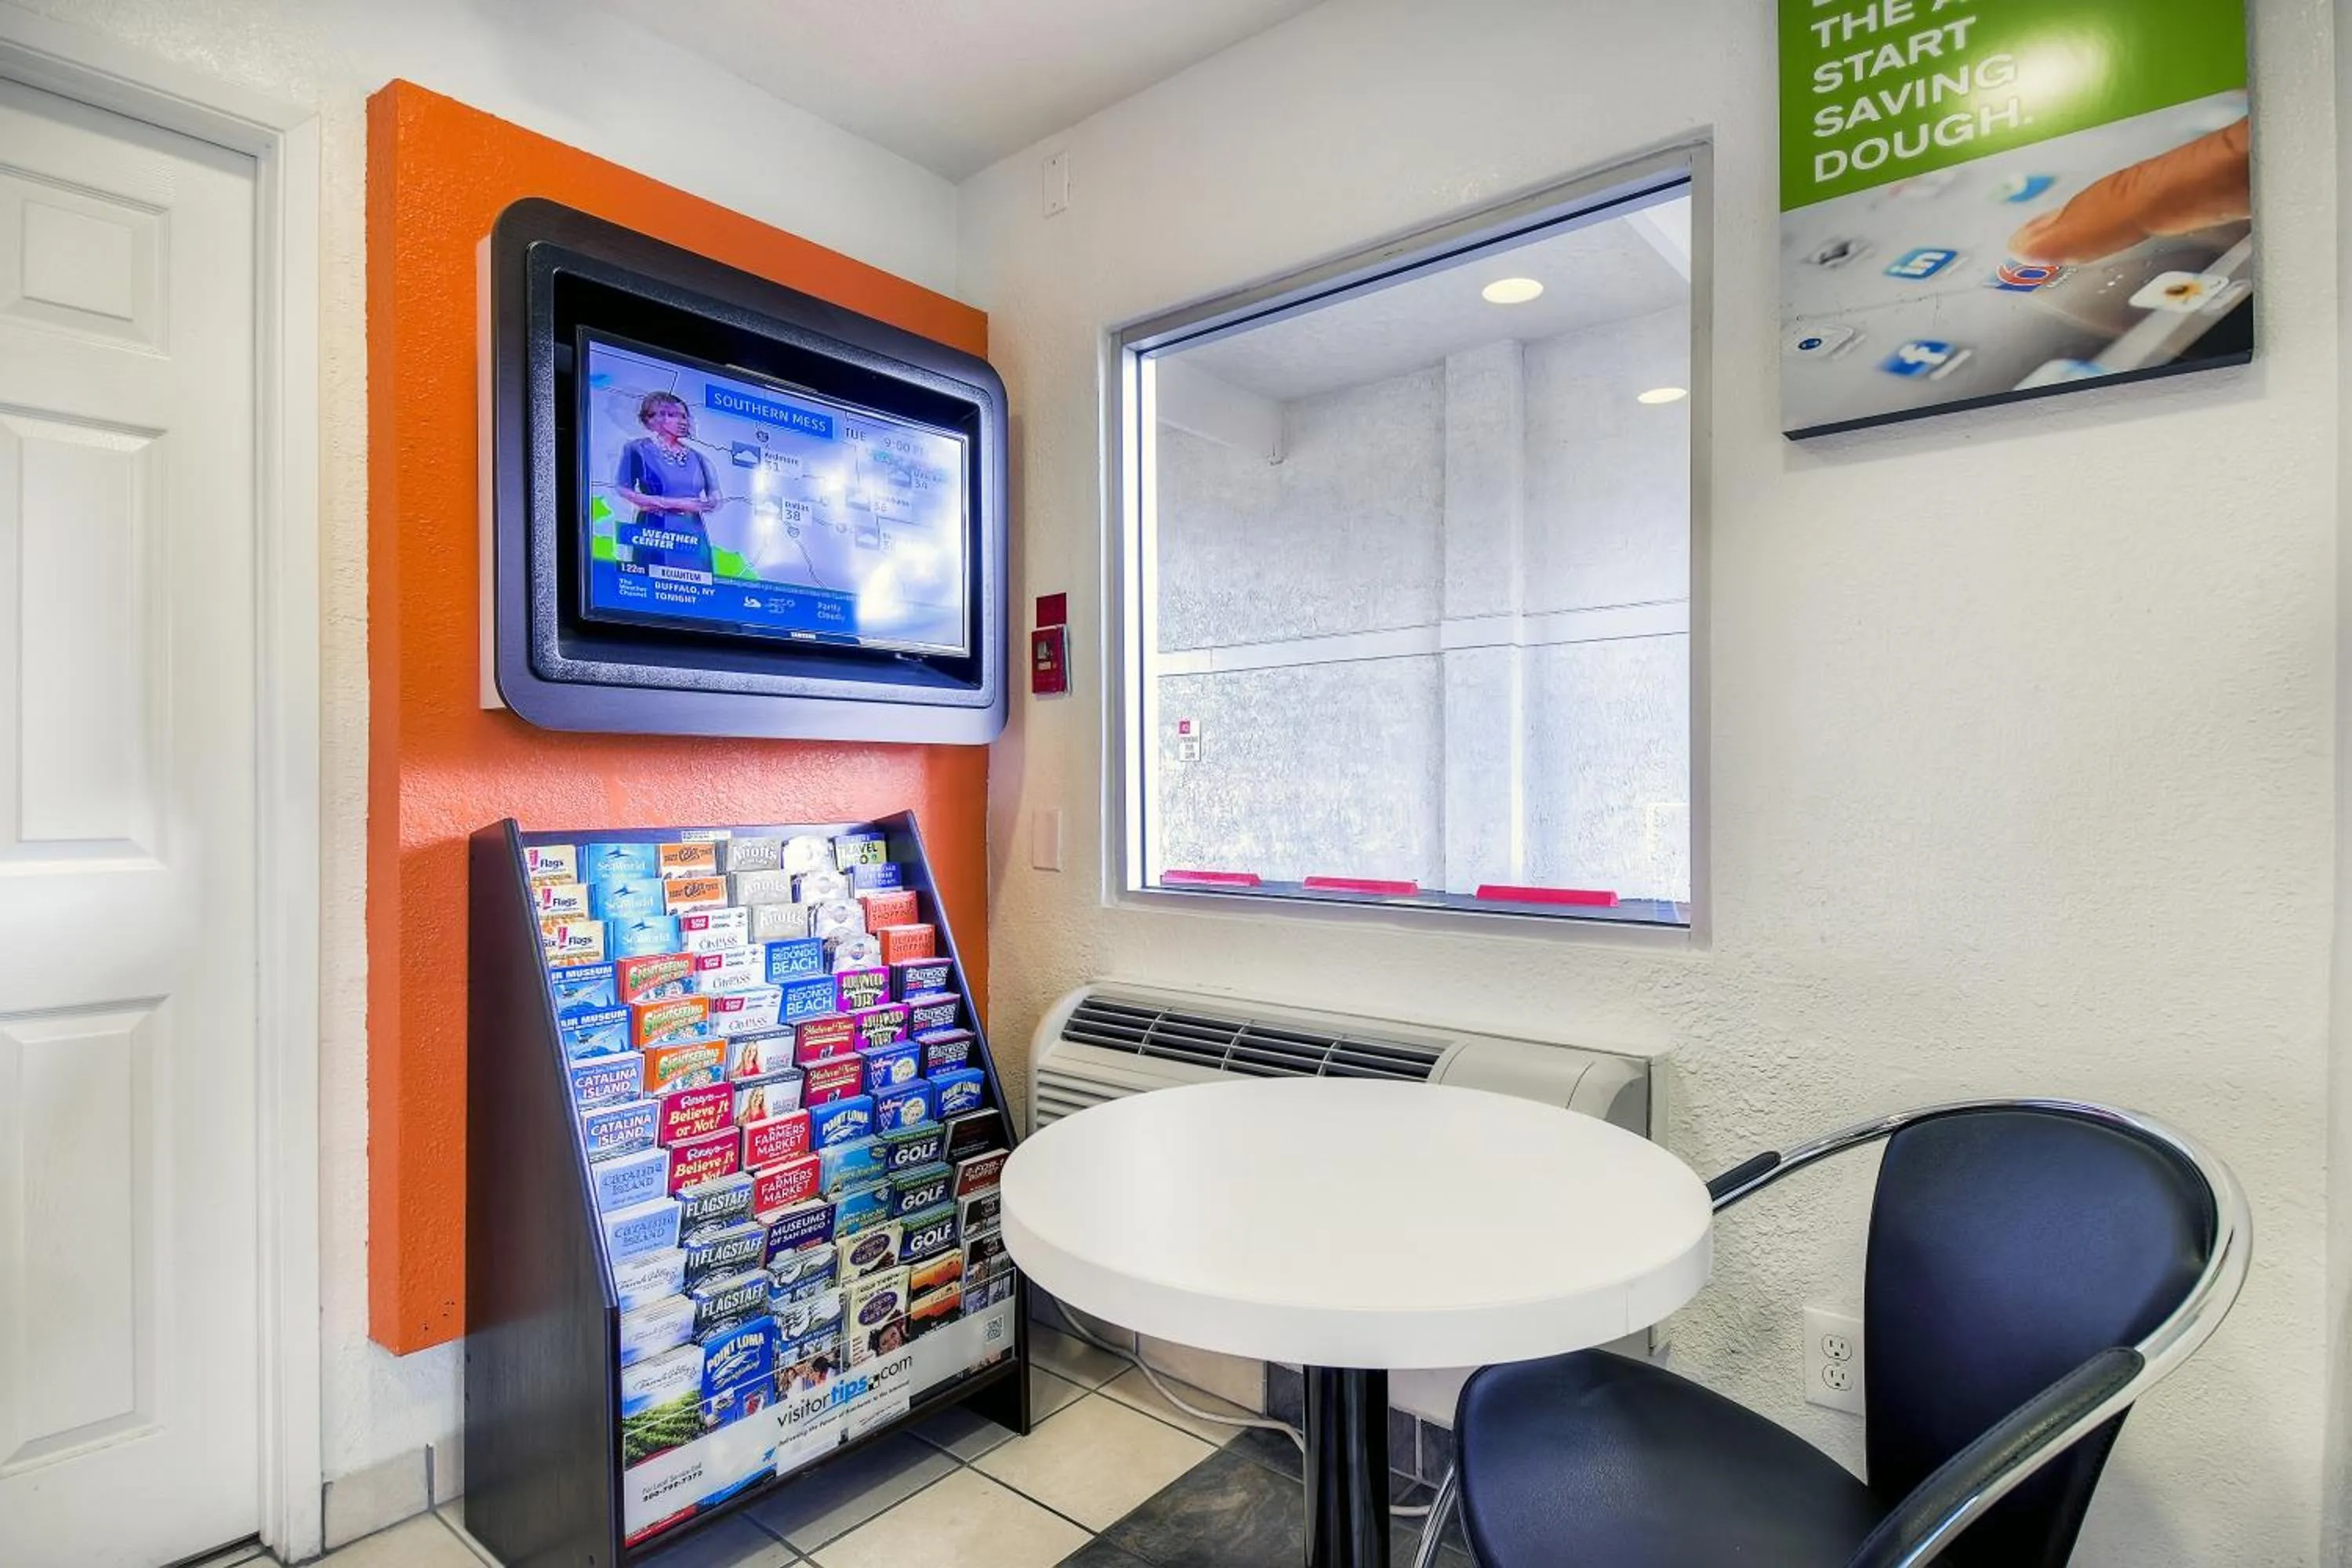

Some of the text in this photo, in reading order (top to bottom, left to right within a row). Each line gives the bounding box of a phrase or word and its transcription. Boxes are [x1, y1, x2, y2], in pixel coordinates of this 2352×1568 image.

[1810, 0, 1915, 48] THE
[1813, 16, 1977, 93] START
[1813, 53, 2016, 138] SAVING
[1814, 97, 2034, 183] DOUGH.
[713, 393, 827, 433] SOUTHERN MESS
[845, 427, 866, 441] TUE
[884, 437, 910, 453] 9:00
[631, 535, 675, 550] CENTER
[642, 528, 699, 545] WEATHER
[552, 898, 578, 907] Flags
[568, 936, 593, 946] Flags
[771, 958, 818, 976] BEACH
[772, 949, 817, 964] REDONDO
[565, 964, 613, 979] MUSEUM
[786, 996, 834, 1016] BEACH
[787, 985, 833, 1002] REDONDO
[580, 1008, 628, 1025] MUSEUM
[575, 1066, 638, 1089] CATALINA
[583, 1082, 631, 1099] ISLAND
[590, 1113, 652, 1137] CATALINA
[668, 1099, 730, 1126] Believe It
[597, 1126, 645, 1145] ISLAND
[675, 1114, 723, 1138] or Not!
[755, 1122, 806, 1147] FARMERS
[756, 1134, 802, 1159] MARKET
[895, 1142, 938, 1165] GOLF
[673, 1151, 735, 1178] Believe It
[760, 1167, 814, 1196] FARMERS
[762, 1178, 811, 1206] MARKET
[686, 1189, 752, 1218] FLAGSTAFF
[902, 1185, 946, 1211] GOLF
[769, 1221, 827, 1247] OF SAN DIEGO
[770, 1210, 827, 1238] MUSEUMS
[909, 1221, 953, 1252] GOLF
[702, 1236, 763, 1265] FLAGSTAFF
[702, 1282, 766, 1318] FLAGSTAFF
[706, 1340, 735, 1373] POINT
[736, 1332, 765, 1348] LOMA
